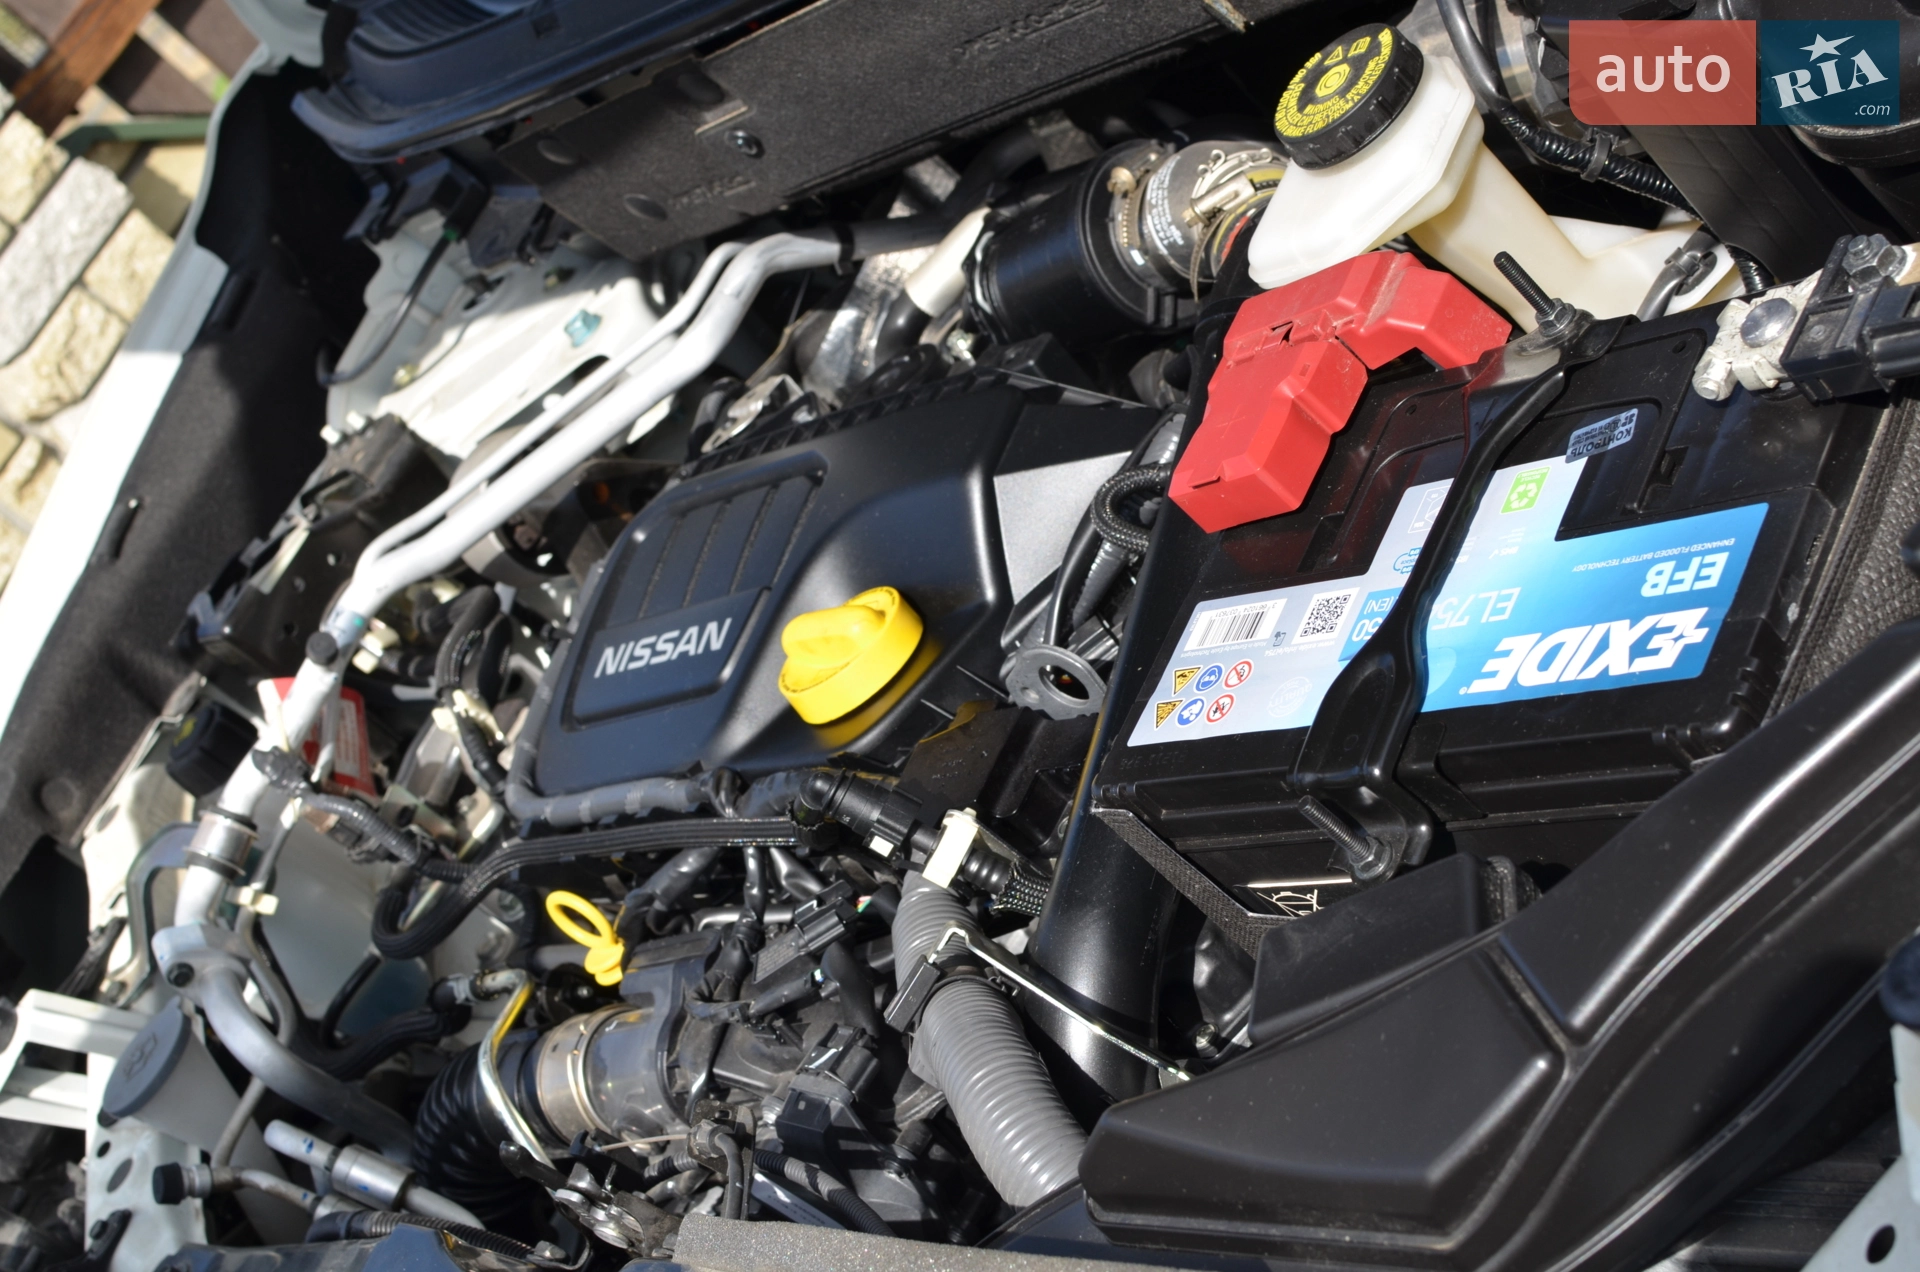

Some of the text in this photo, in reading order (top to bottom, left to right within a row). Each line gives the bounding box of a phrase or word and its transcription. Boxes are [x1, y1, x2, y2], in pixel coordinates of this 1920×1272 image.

[1304, 52, 1322, 69] USE
[1287, 68, 1307, 90] ONLY
[1297, 114, 1314, 127] CAP
[1311, 97, 1347, 123] BEFORE
[1346, 55, 1381, 100] REMOVING
[1358, 63, 1385, 95] SEALED
[1303, 95, 1340, 115] WARNING
[1328, 100, 1355, 123] FROM
[1353, 94, 1361, 103] A
[1571, 427, 1632, 457] КОНТРОЛЬ
[1571, 538, 1736, 573] ENHANCED FLOODED BATTERY TECHNOLOGY
[1640, 551, 1730, 598] EFB
[1351, 616, 1383, 642] 50
[594, 617, 732, 679] NISSAN
[1466, 606, 1710, 694] EXIDE
